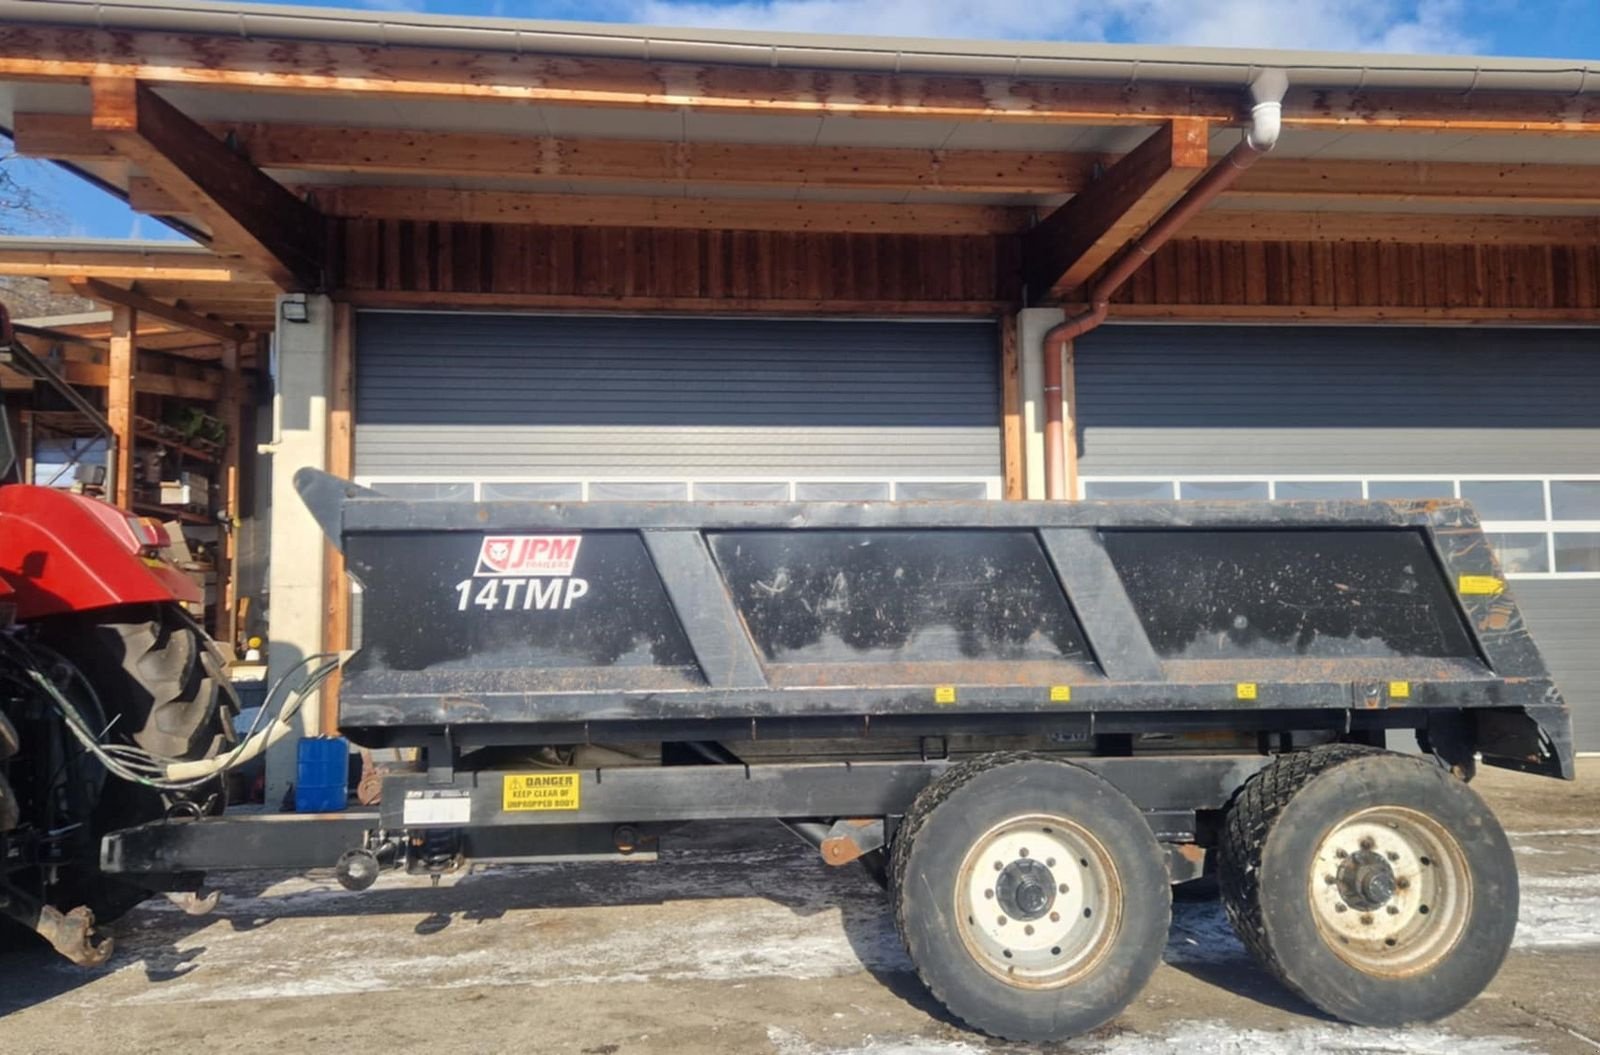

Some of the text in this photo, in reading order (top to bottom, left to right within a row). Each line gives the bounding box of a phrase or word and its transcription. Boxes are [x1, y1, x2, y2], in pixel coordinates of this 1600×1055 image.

[510, 538, 577, 569] JPM
[455, 578, 589, 611] 14TMP
[525, 776, 573, 787] DANGER
[513, 788, 569, 798] KEEP CLEAR OF
[554, 799, 575, 808] BODY
